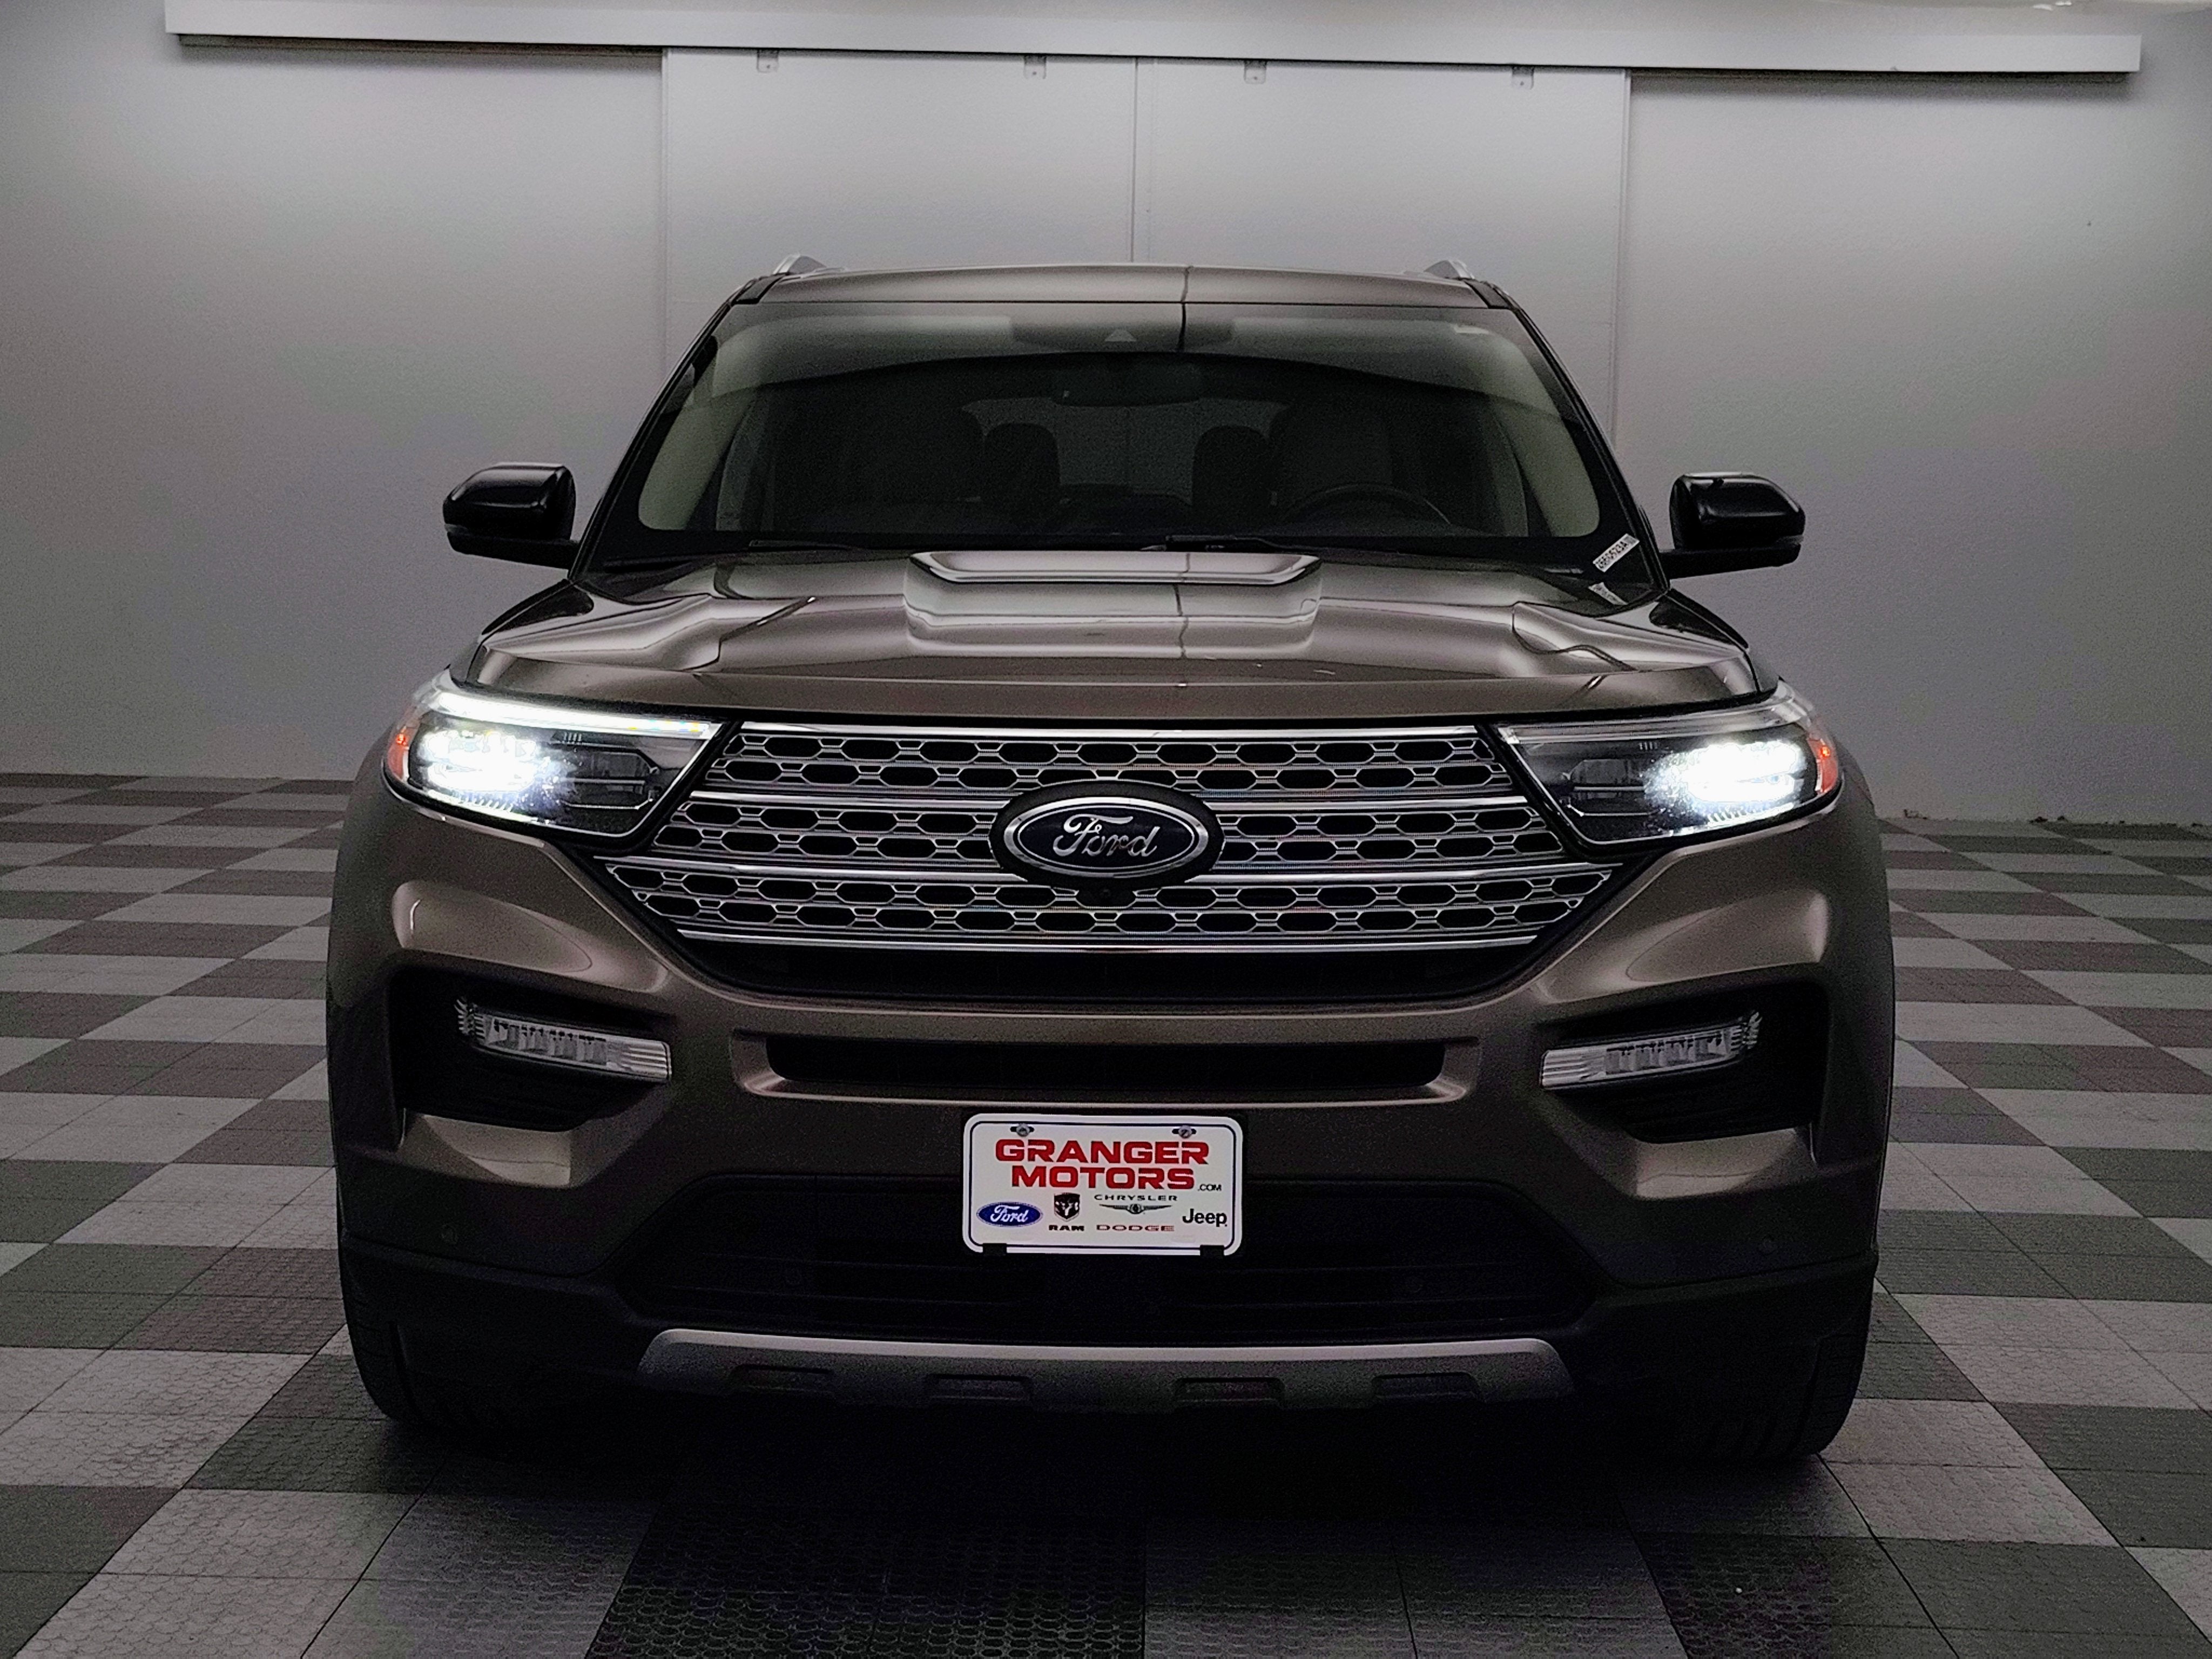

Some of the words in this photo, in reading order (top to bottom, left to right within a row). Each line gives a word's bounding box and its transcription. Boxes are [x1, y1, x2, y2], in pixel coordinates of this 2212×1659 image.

[1053, 813, 1161, 857] Ford
[995, 1138, 1209, 1165] GRANGER
[1011, 1165, 1195, 1190] MOTORS
[1094, 1193, 1178, 1202] CHRYSLER
[990, 1204, 1029, 1223] Ford
[1182, 1208, 1228, 1227] Jeep
[1096, 1224, 1175, 1232] DODGE
